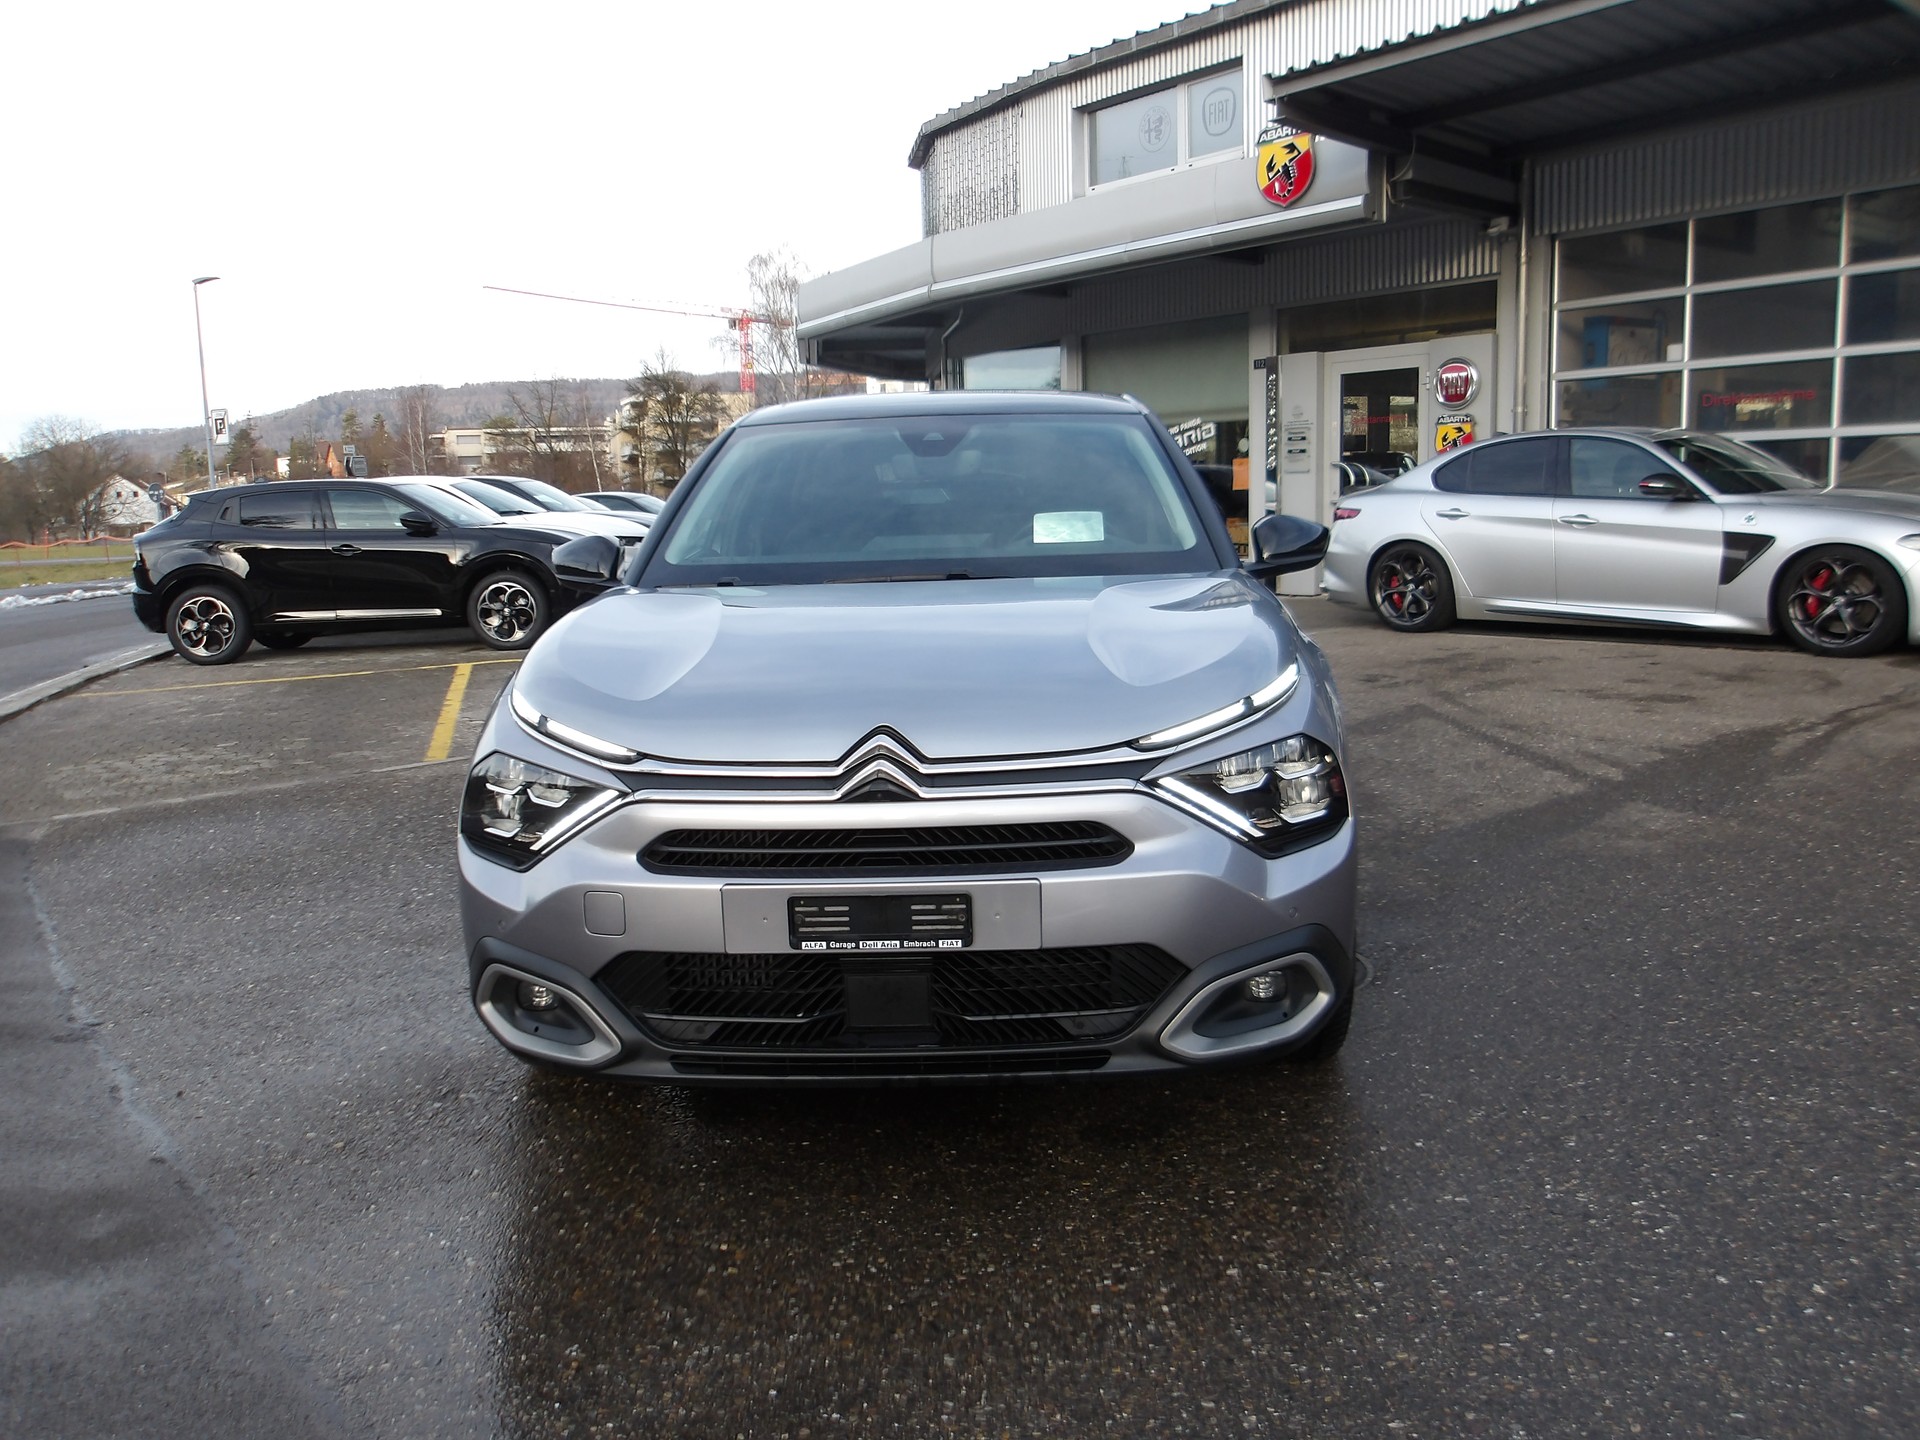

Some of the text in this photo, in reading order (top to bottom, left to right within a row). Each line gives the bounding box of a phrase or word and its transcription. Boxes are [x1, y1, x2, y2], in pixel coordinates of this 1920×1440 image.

[1208, 98, 1230, 126] FIAT
[1259, 126, 1301, 143] ABAR
[1255, 360, 1265, 368] 112
[1438, 415, 1471, 424] ABARTH
[1183, 442, 1207, 456] DITION
[829, 941, 856, 949] Garage
